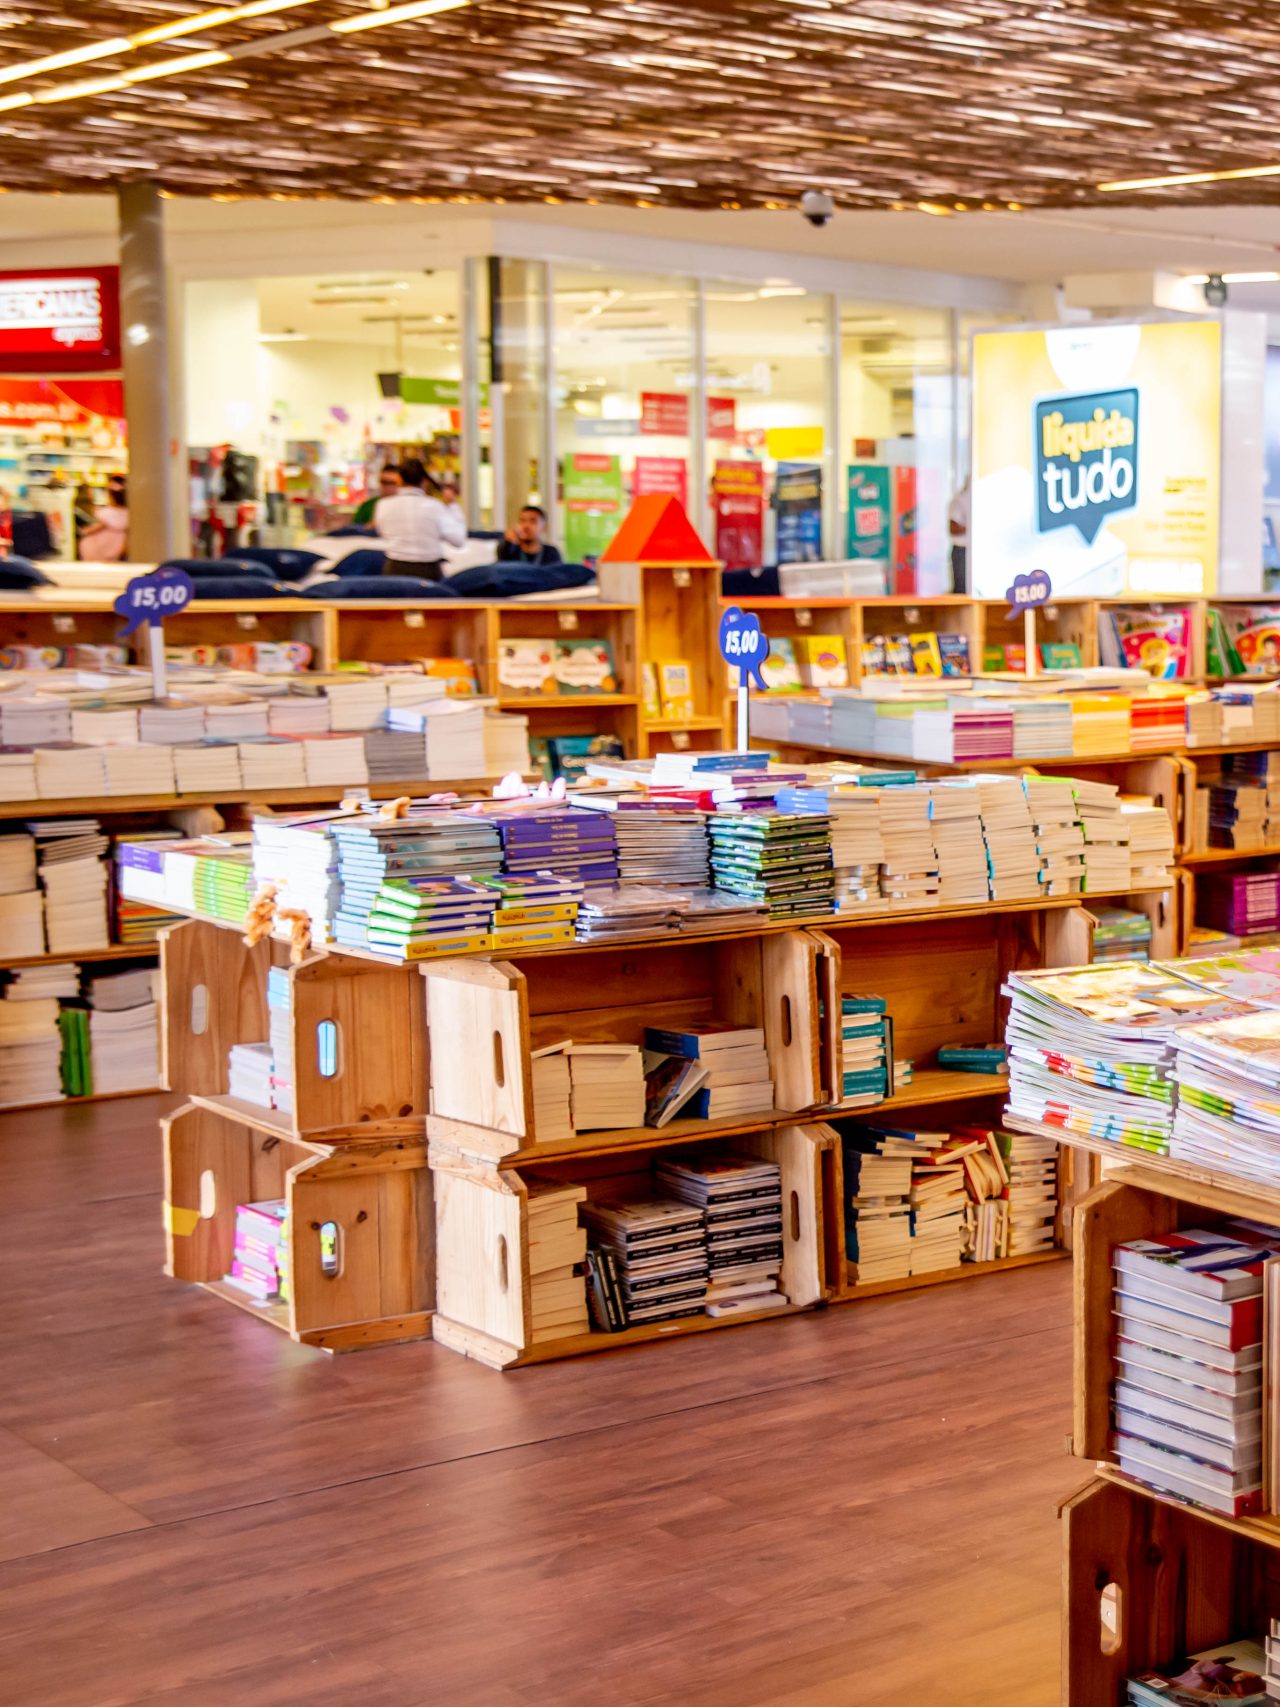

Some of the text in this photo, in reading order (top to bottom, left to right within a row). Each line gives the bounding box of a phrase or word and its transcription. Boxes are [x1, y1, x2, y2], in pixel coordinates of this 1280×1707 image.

[1043, 407, 1134, 462] liquida
[1043, 448, 1134, 514] tudo
[133, 584, 188, 611] 15,00
[725, 629, 759, 656] 15,00
